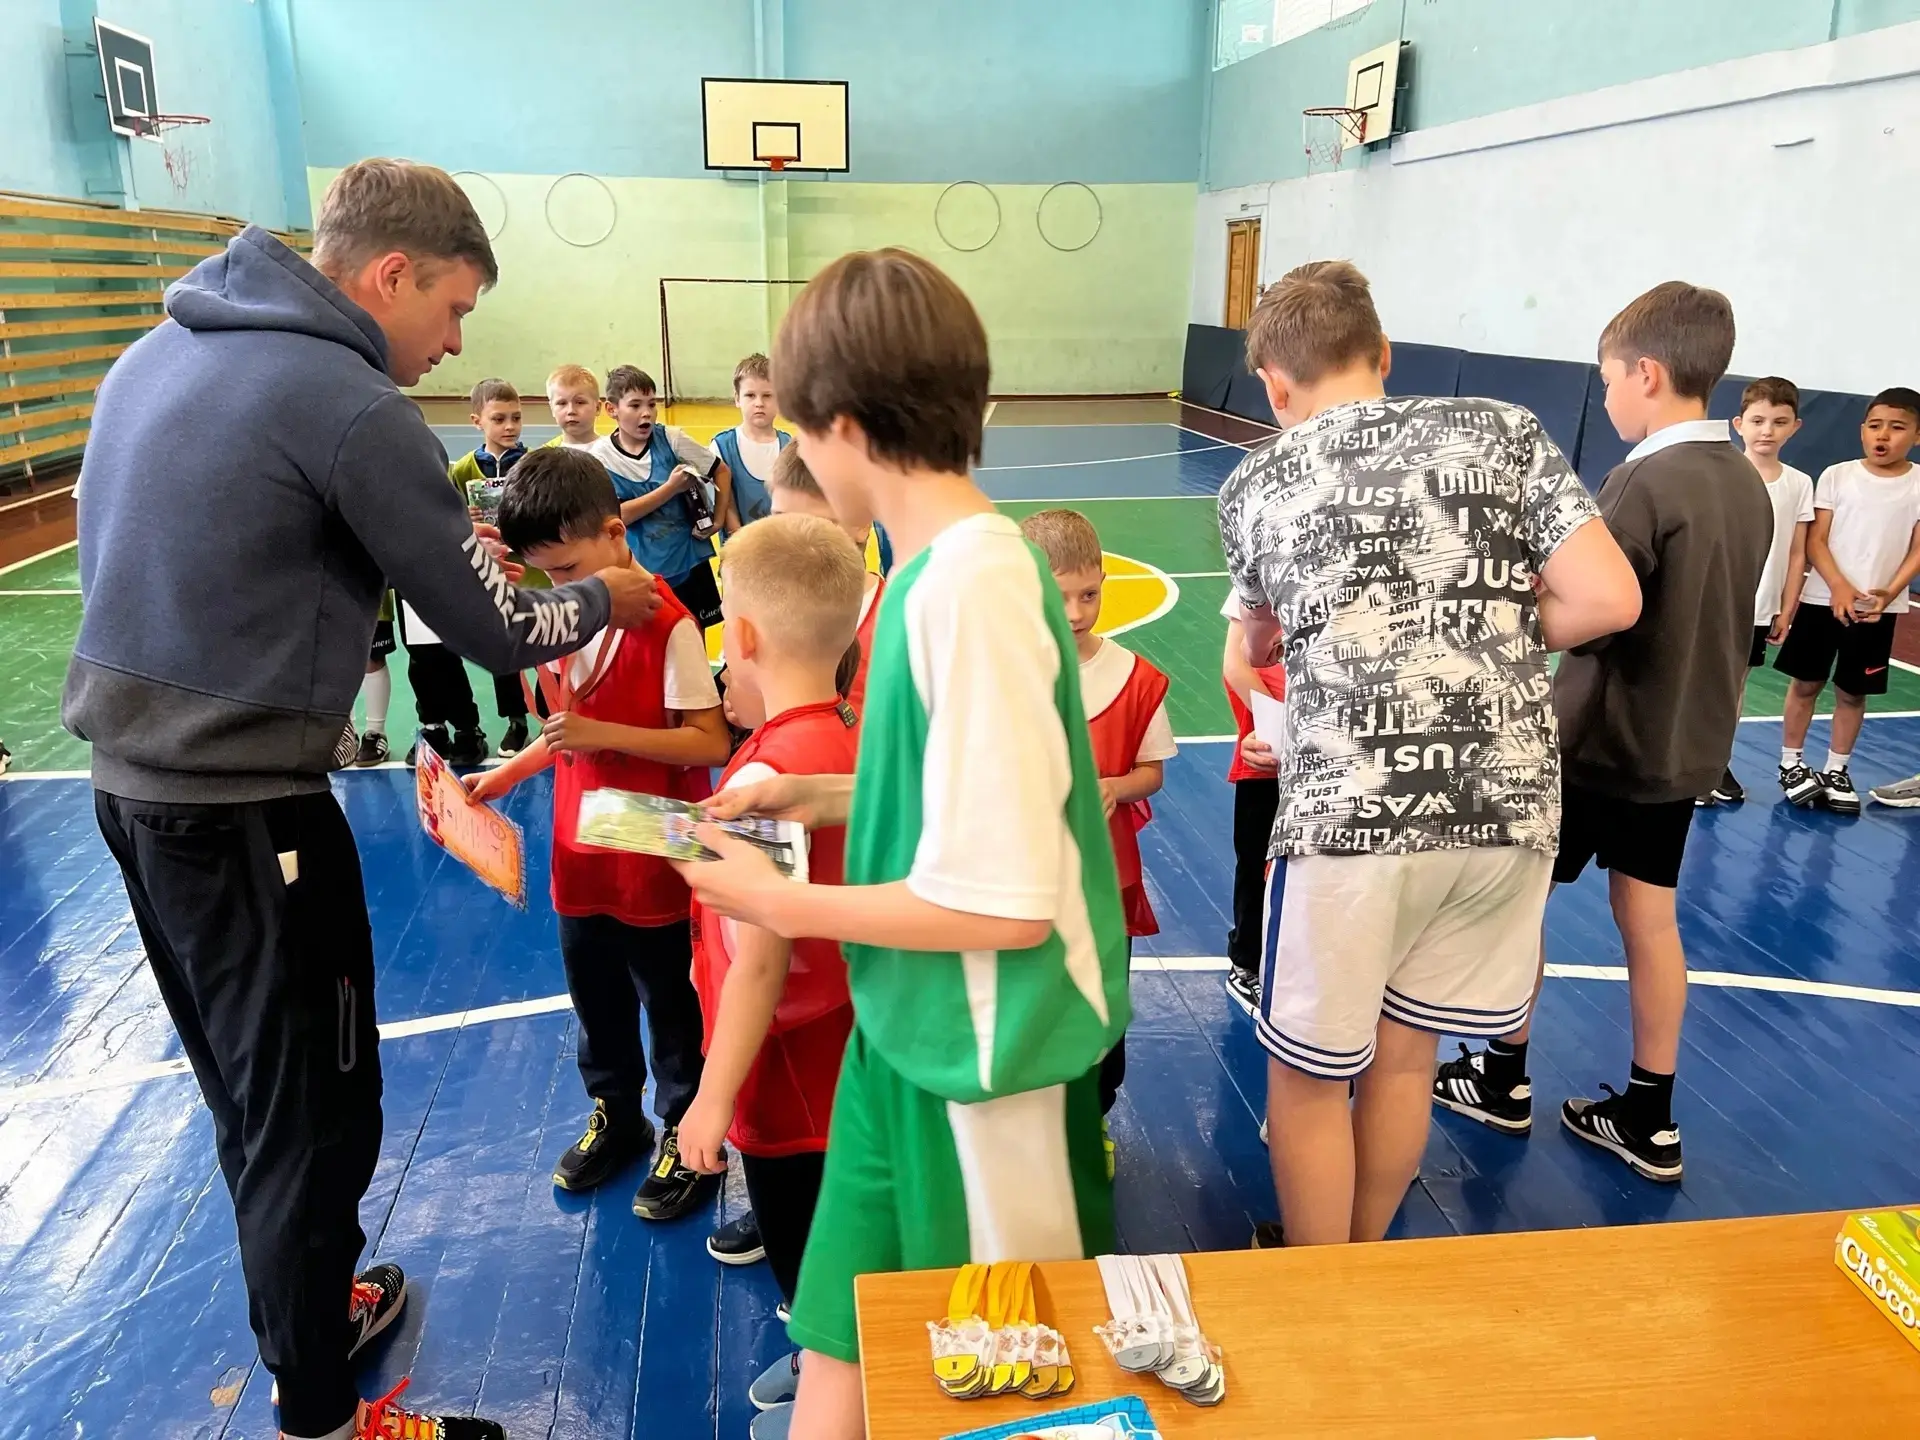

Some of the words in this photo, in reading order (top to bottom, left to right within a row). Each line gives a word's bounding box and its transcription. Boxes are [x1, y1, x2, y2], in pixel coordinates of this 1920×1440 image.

[1327, 486, 1412, 508] JUST
[1360, 656, 1407, 676] WAS
[1304, 785, 1342, 799] JUST
[1357, 791, 1457, 819] WAS
